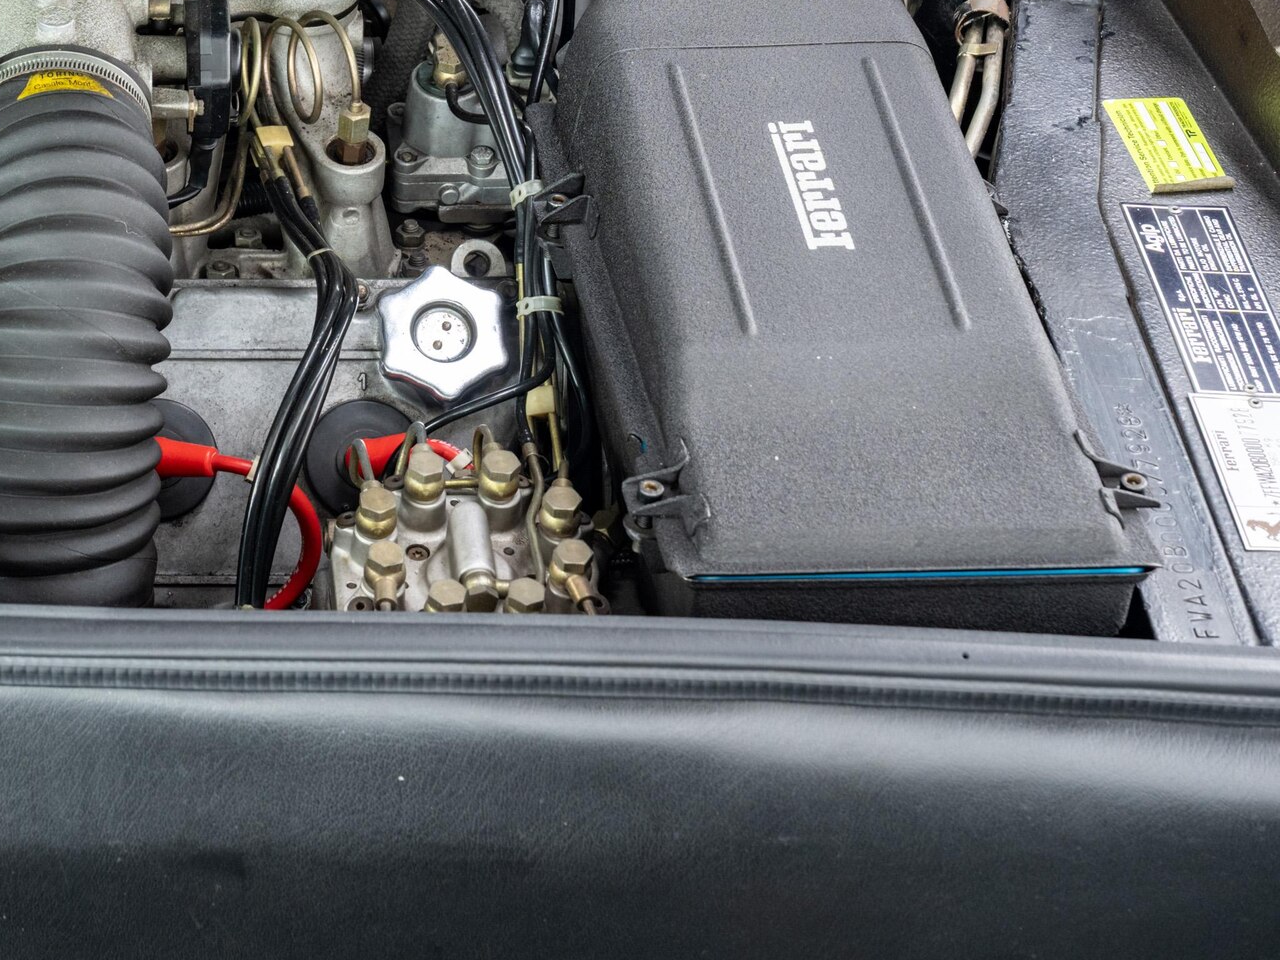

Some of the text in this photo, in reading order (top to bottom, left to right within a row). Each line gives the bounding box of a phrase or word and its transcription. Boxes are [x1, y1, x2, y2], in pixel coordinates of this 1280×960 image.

[1116, 110, 1159, 184] ttention Service Technician
[767, 120, 856, 250] Ferrari
[1140, 223, 1165, 253] Agip
[1171, 307, 1213, 363] Ferrari
[356, 372, 368, 392] 1
[1212, 430, 1239, 471] Ferrari
